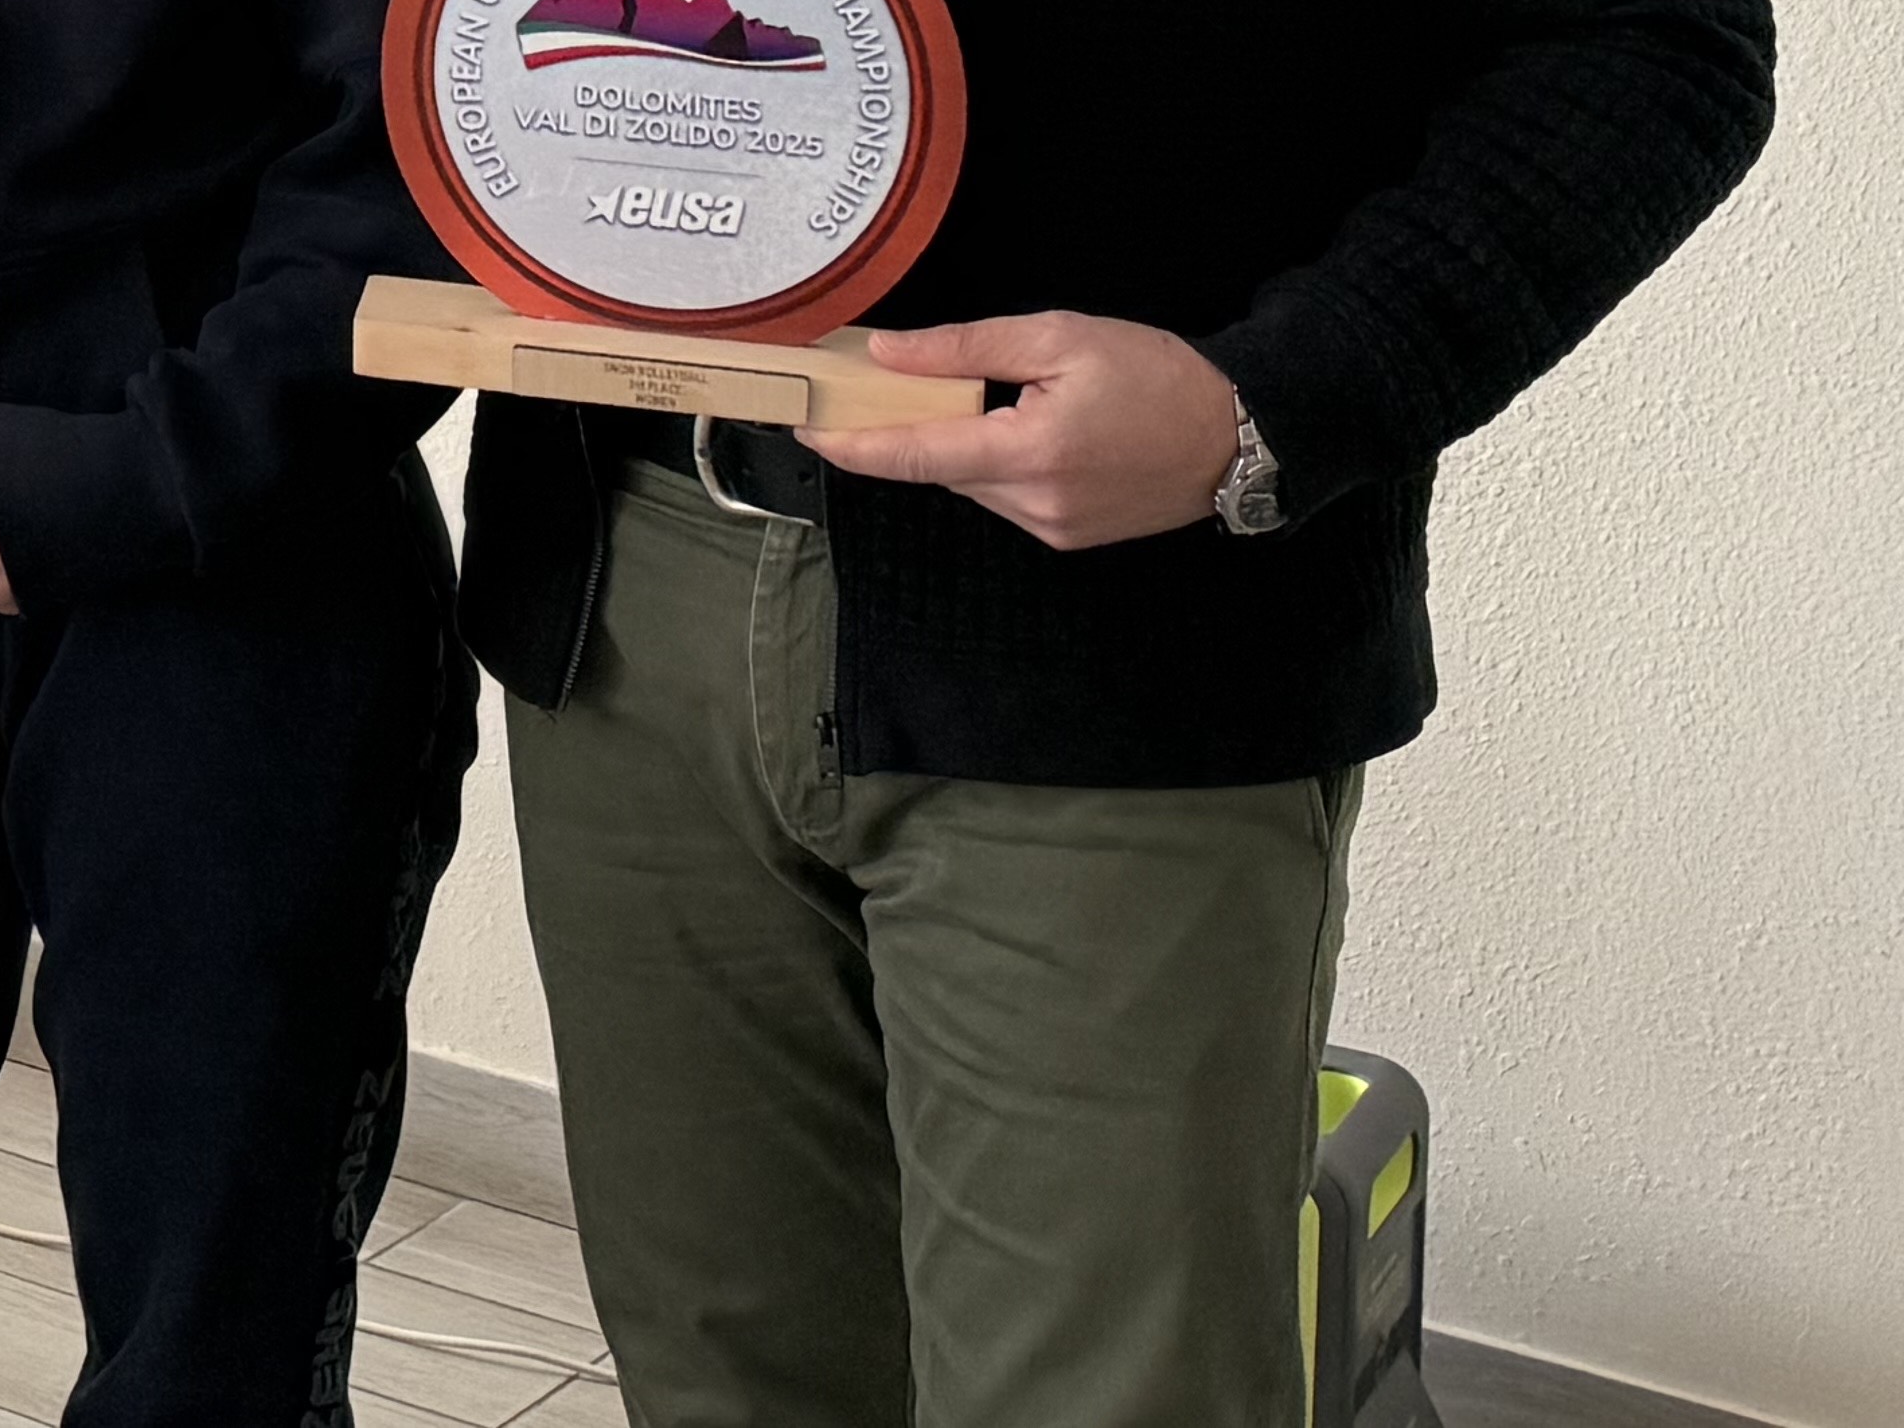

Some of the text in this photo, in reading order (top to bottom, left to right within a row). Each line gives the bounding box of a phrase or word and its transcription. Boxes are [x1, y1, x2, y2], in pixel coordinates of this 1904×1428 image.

[451, 16, 520, 199] EUROPEAN
[574, 84, 762, 123] DOLOMITES
[513, 104, 825, 159] VAL DI ZOLDO 2025
[618, 185, 746, 235] eusa
